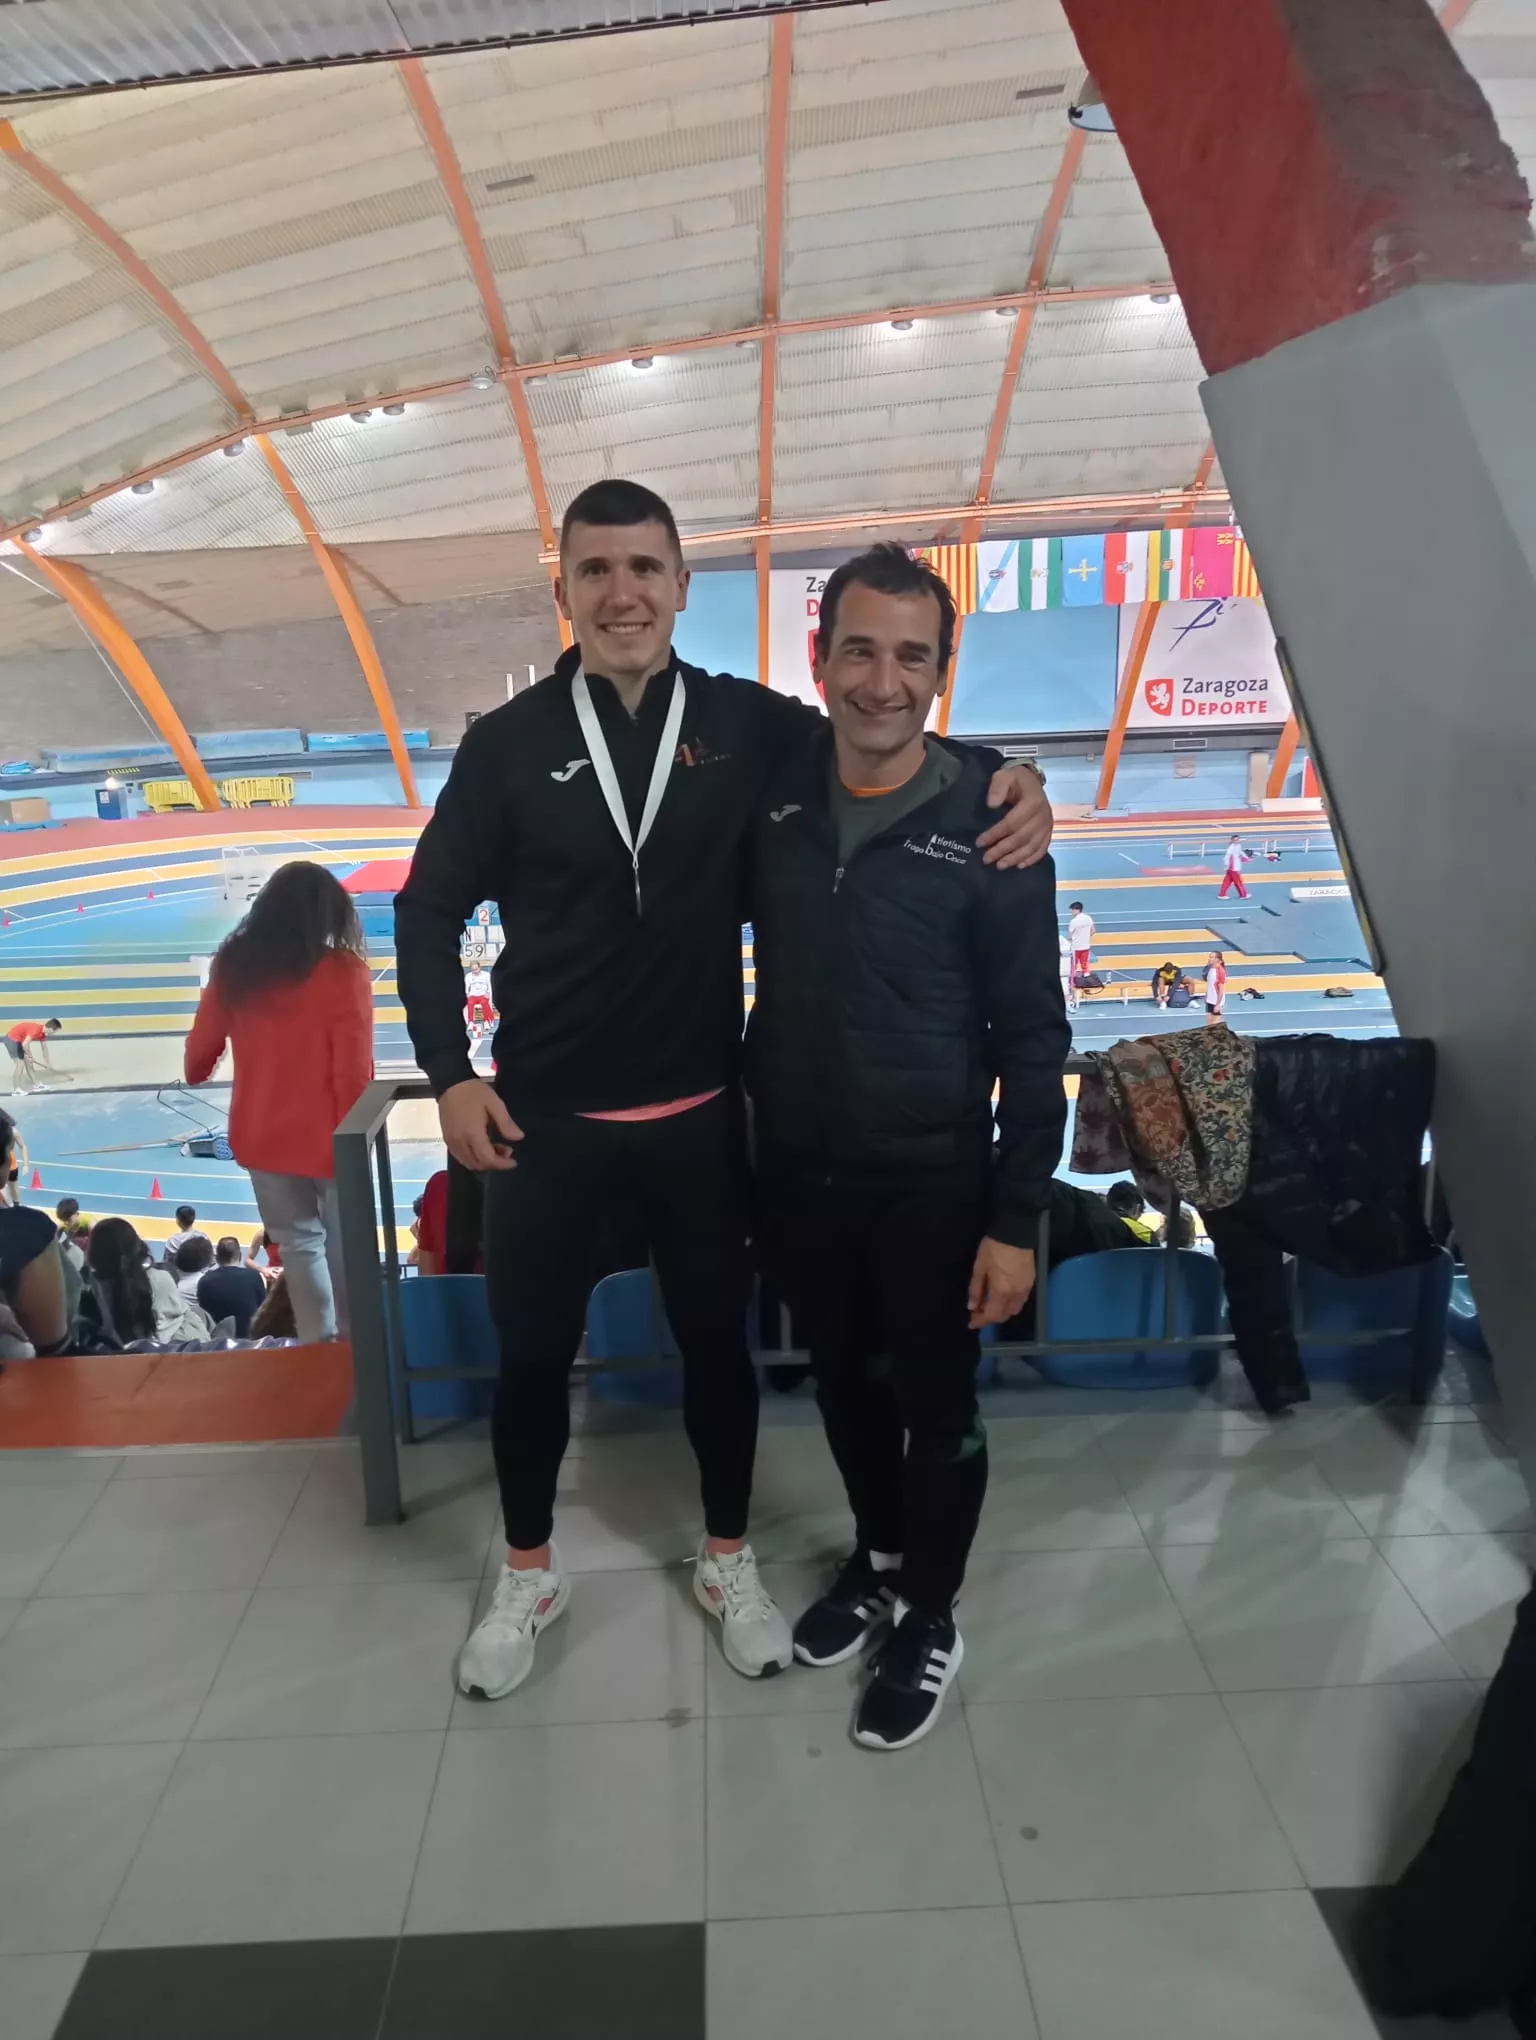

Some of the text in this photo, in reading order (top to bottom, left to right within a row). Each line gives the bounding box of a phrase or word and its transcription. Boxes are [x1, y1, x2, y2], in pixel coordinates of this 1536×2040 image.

[1182, 677, 1269, 698] Zaragoza
[1181, 698, 1268, 716] DEPORTE
[479, 908, 489, 922] 2
